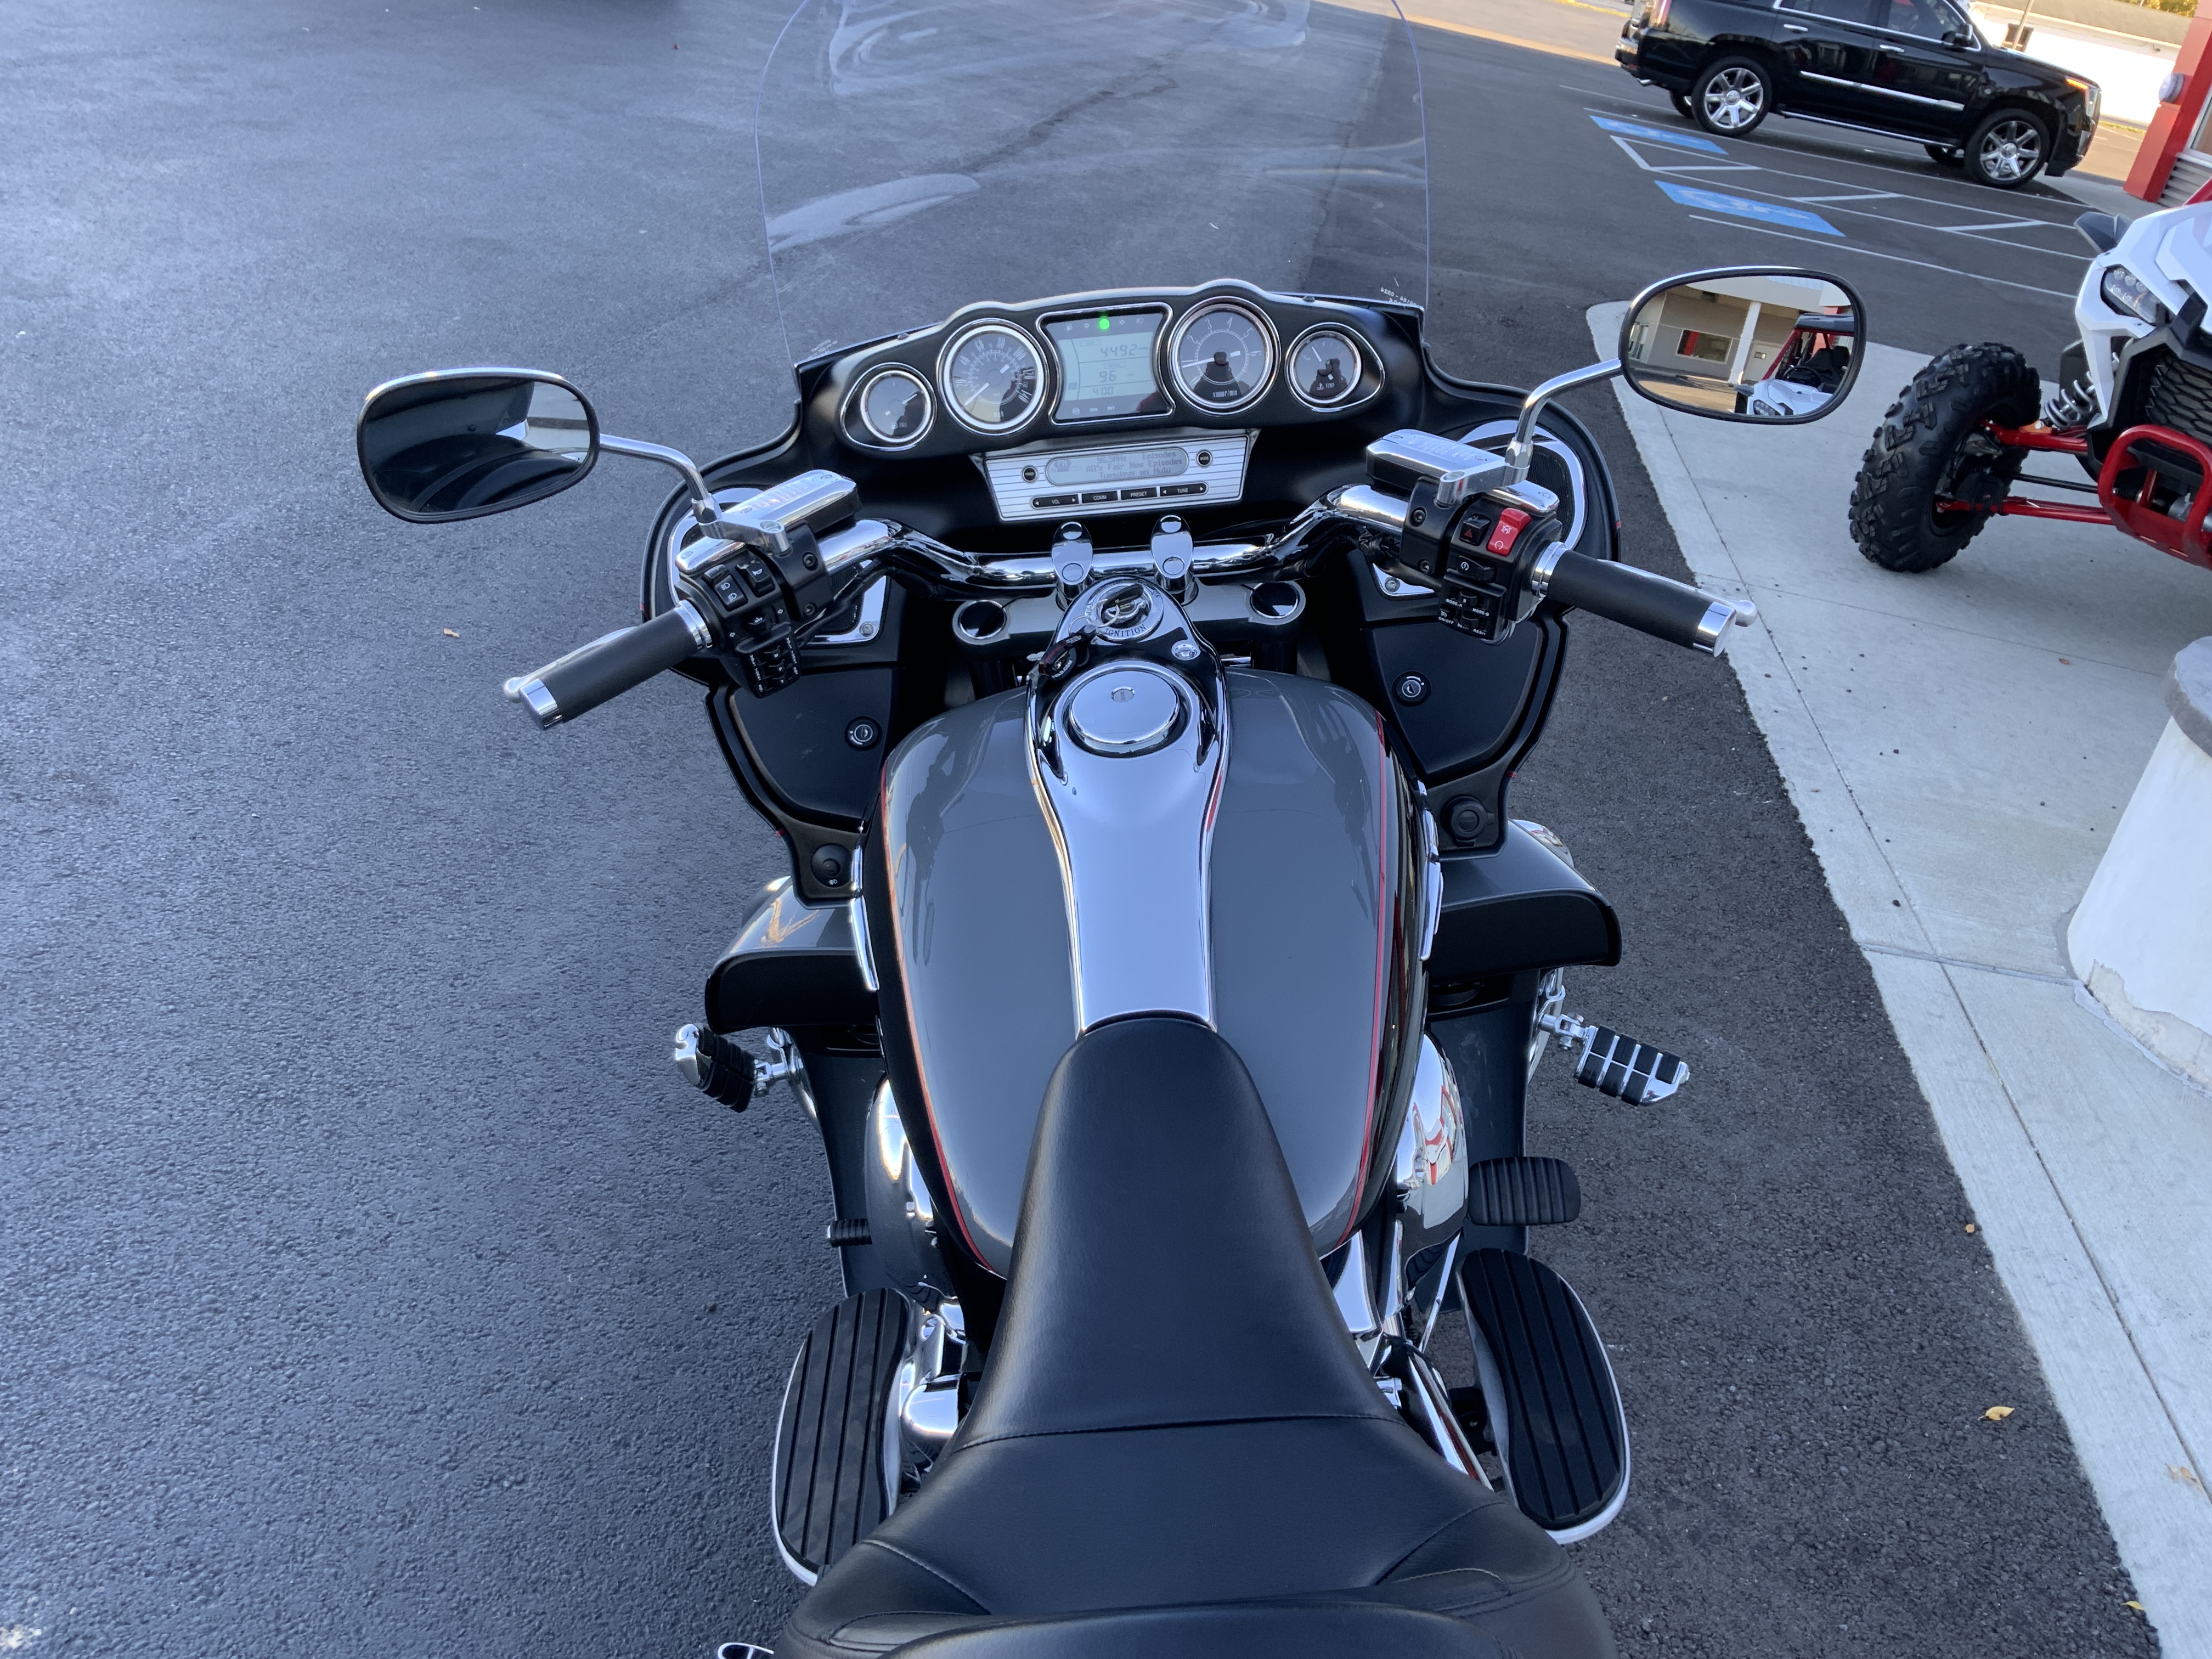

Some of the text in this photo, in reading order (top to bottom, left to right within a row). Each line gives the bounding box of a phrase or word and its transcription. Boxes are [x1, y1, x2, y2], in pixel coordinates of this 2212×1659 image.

[1205, 319, 1212, 329] 3
[1227, 317, 1233, 328] 4
[1243, 328, 1254, 338] 5
[1187, 335, 1198, 344] 2
[1100, 344, 1137, 357] 4492
[960, 356, 970, 365] 40
[1023, 368, 1035, 379] 120
[1099, 370, 1116, 382] 96
[1018, 390, 1032, 403] 140
[1142, 451, 1176, 460] Episodes
[1108, 462, 1125, 471] Fair
[1149, 458, 1182, 467] Episodes
[1446, 599, 1462, 607] MODE-A
[1472, 608, 1489, 617] MODE-B
[1105, 624, 1146, 637] IGNITION
